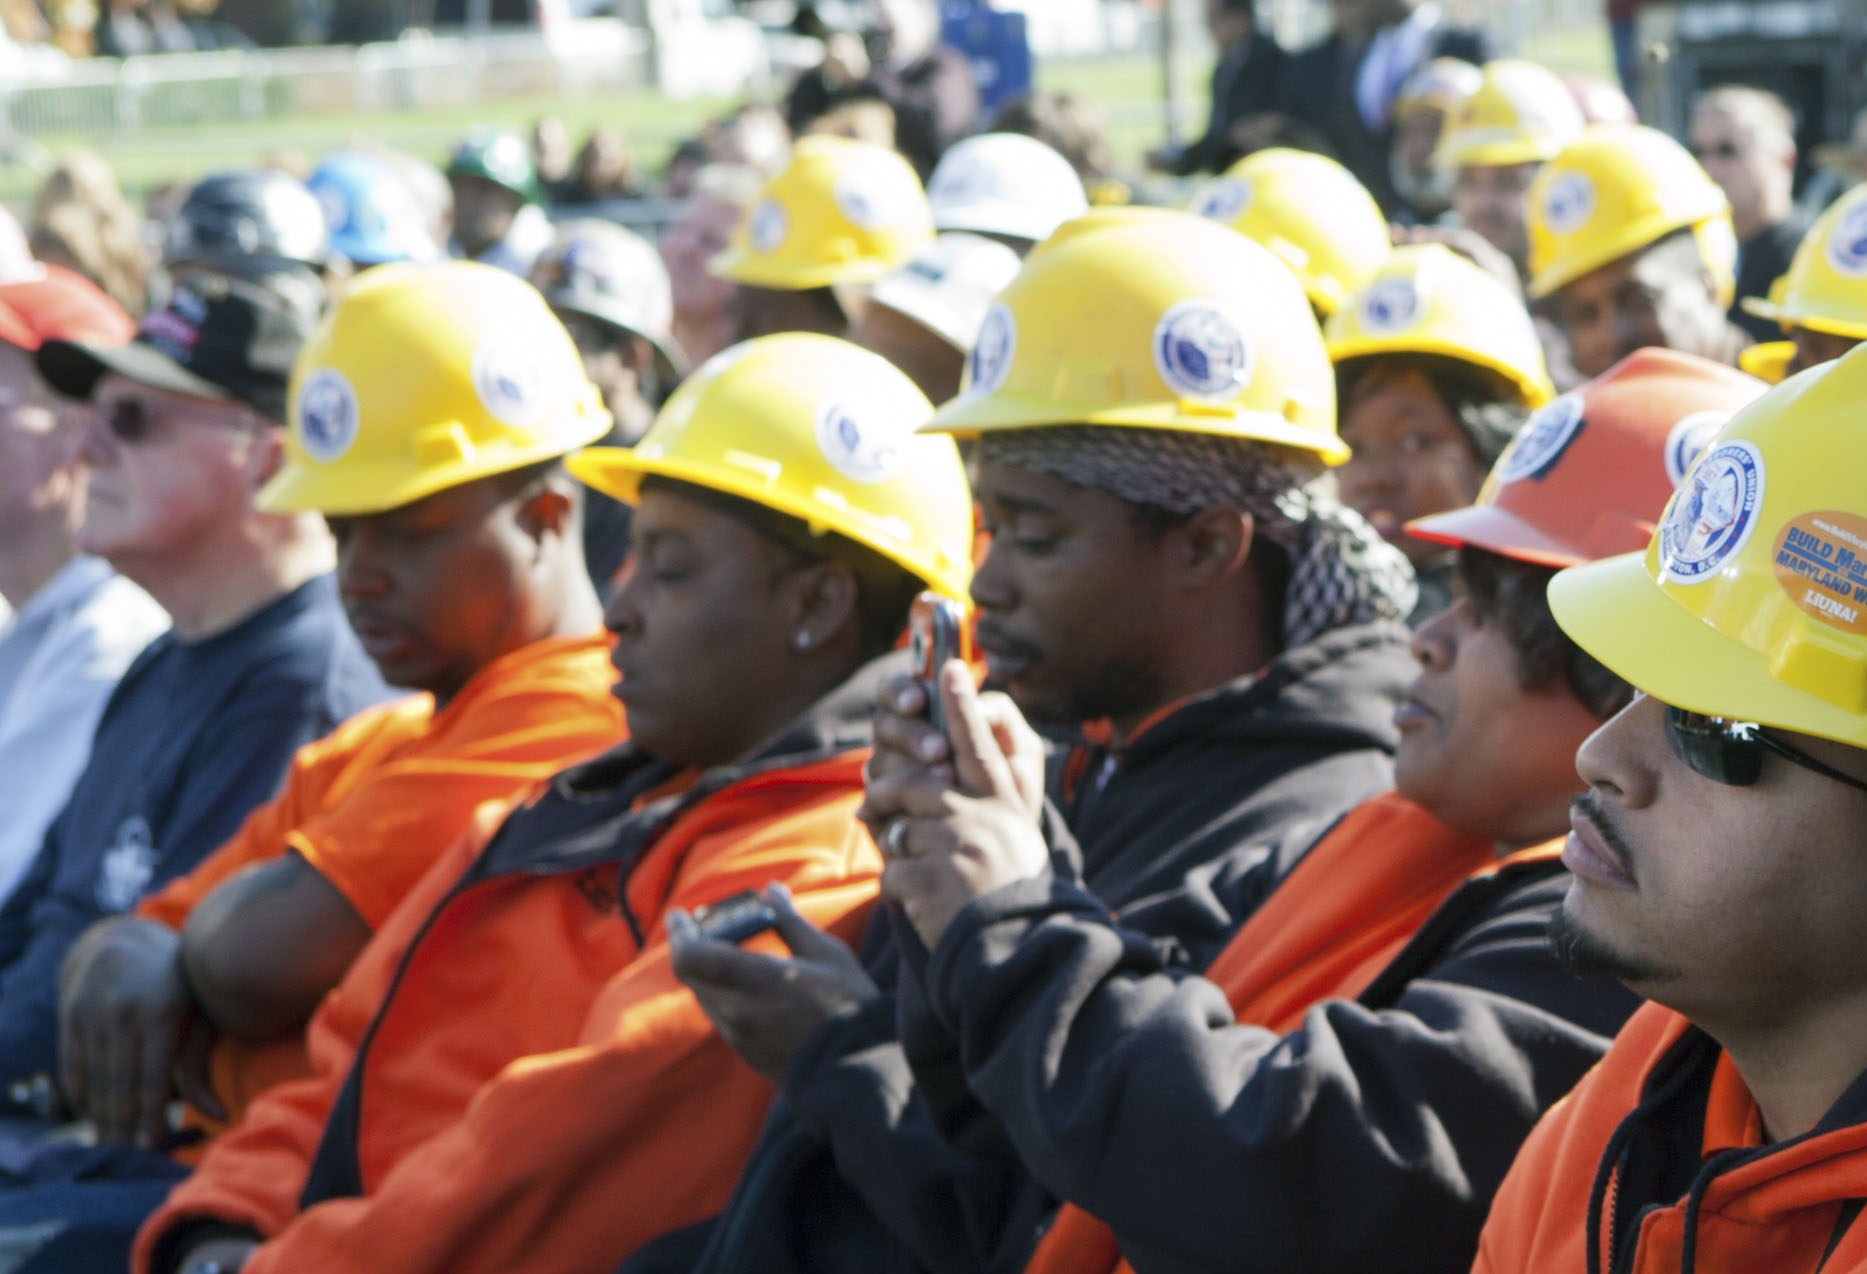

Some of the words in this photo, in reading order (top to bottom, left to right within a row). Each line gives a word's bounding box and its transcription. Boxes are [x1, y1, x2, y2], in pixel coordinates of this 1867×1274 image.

[1743, 468, 1757, 512] UNION
[1786, 526, 1834, 559] BUILD
[1776, 550, 1852, 595] MARYLAND
